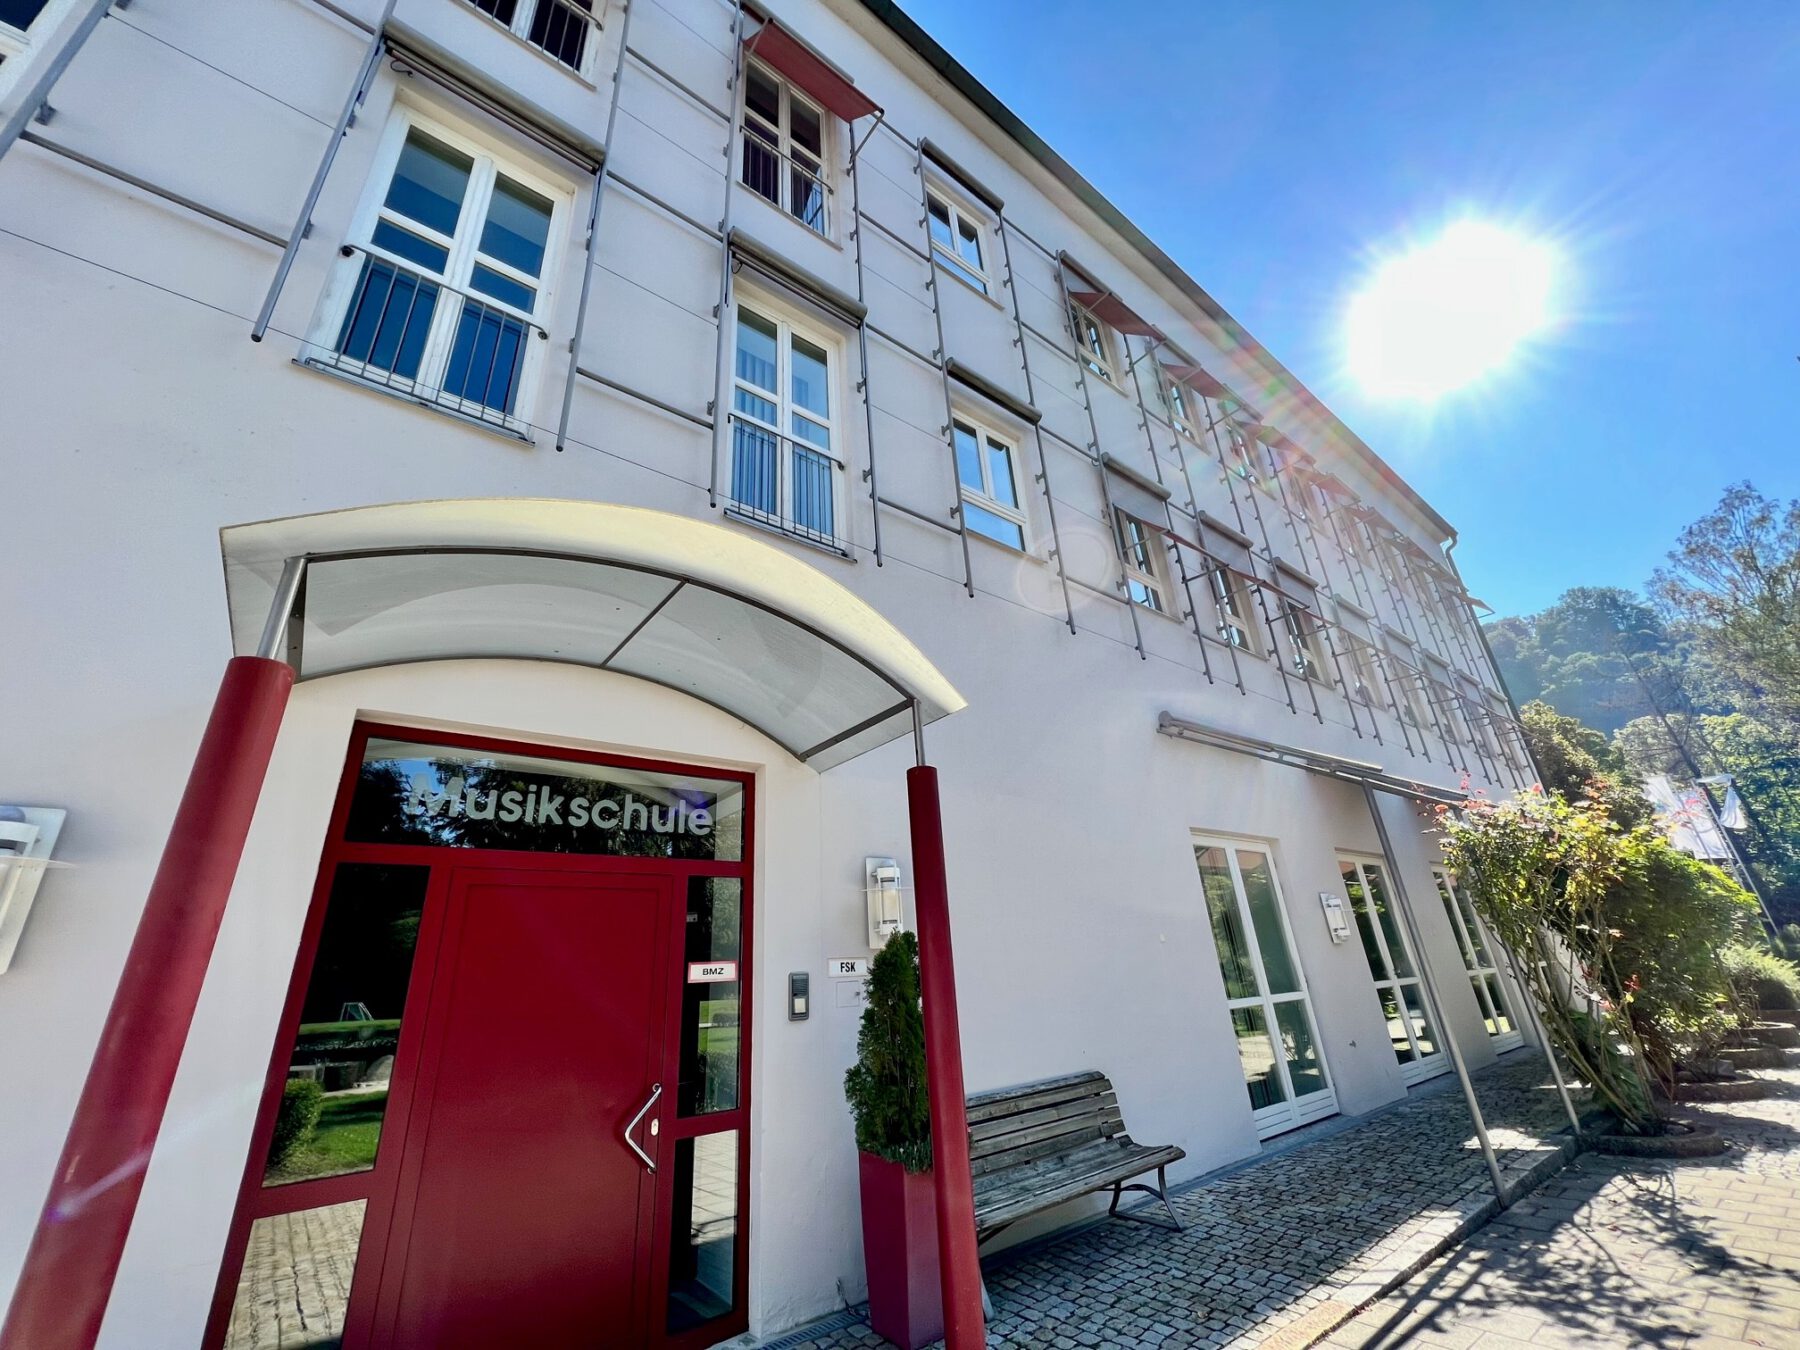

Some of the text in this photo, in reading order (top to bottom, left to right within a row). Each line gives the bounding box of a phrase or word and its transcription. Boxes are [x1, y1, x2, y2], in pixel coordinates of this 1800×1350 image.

[407, 774, 712, 835] Musikschule
[702, 967, 724, 976] BMZ
[840, 961, 856, 973] FSK
